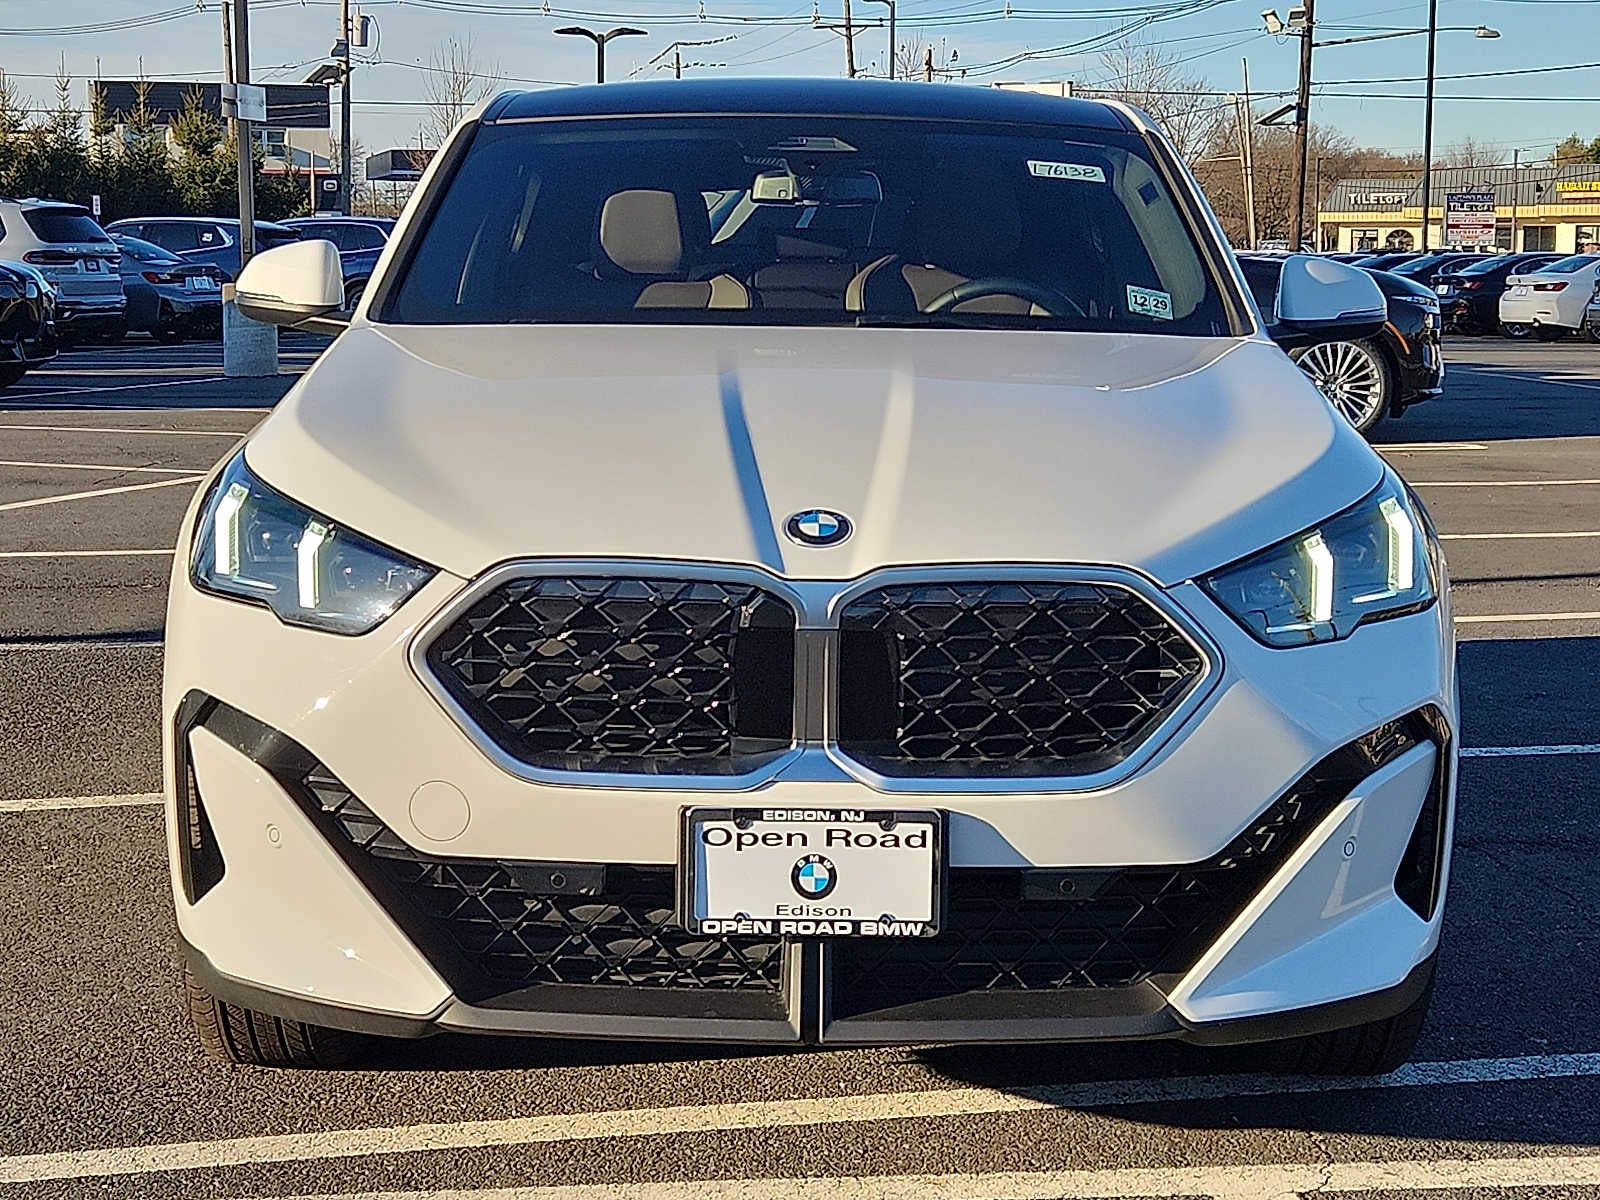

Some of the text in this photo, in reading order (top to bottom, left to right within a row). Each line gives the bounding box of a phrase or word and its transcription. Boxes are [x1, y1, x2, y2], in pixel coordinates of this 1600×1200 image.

[1348, 192, 1408, 204] TILE LOFT
[1449, 202, 1471, 211] TILE
[1132, 294, 1148, 307] 12
[1152, 298, 1168, 311] 29
[762, 810, 866, 822] EDISON, NJ
[702, 827, 928, 851] Open Road
[796, 854, 835, 870] BMW
[775, 904, 853, 917] Edison
[702, 920, 924, 936] OPEN ROAD BMW
